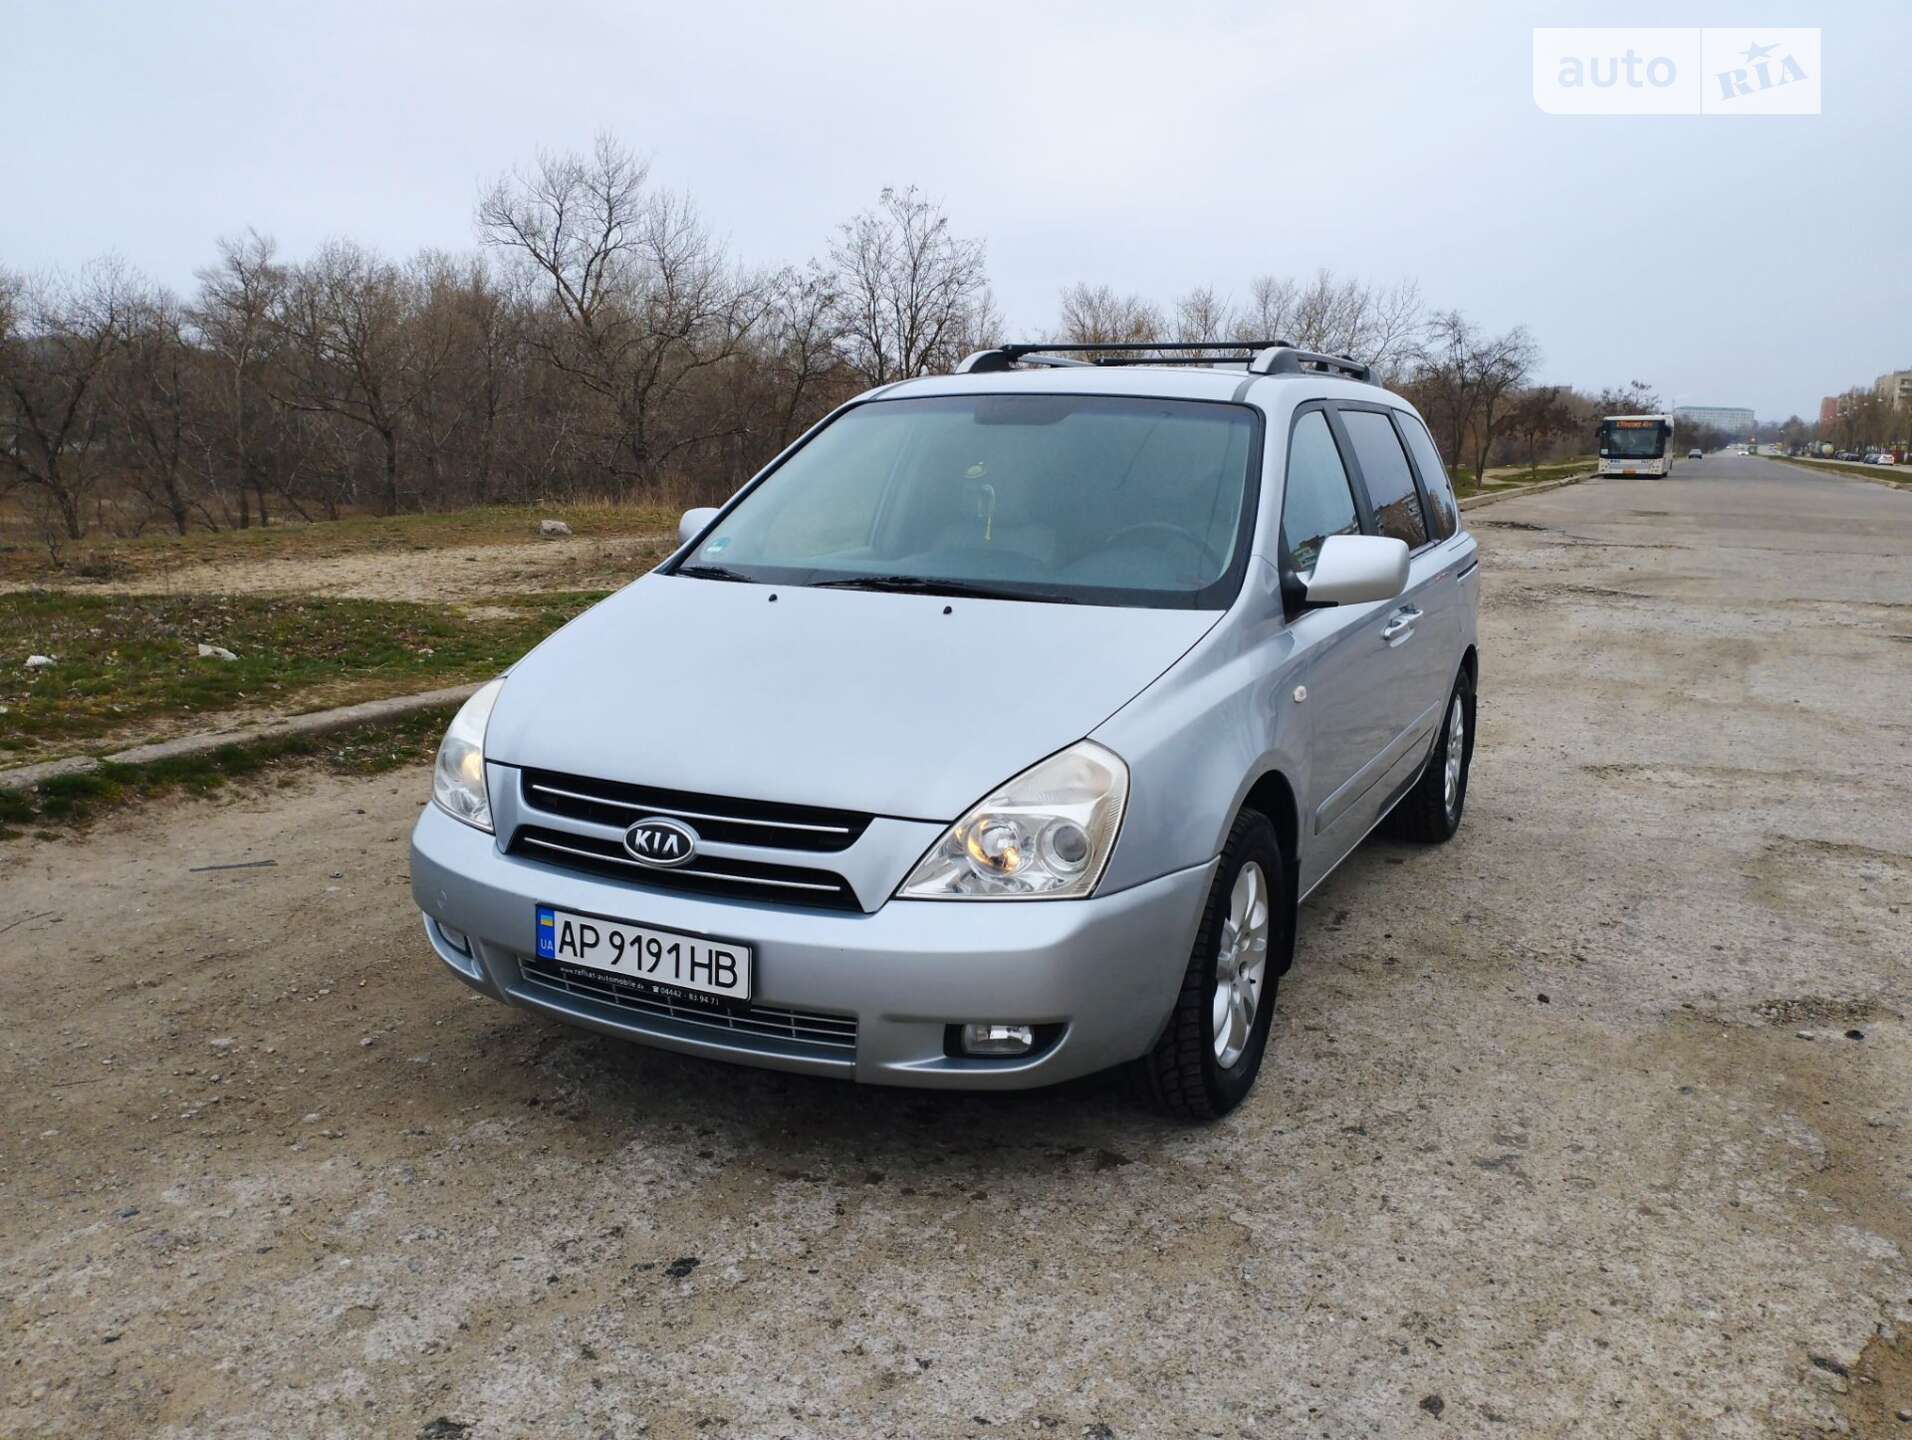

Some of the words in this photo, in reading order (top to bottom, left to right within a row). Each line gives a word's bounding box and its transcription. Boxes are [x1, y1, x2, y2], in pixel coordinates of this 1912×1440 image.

[634, 829, 680, 857] KIA
[539, 937, 554, 951] UA
[558, 920, 600, 958] AP
[609, 931, 681, 979] 9191
[689, 945, 738, 988] HB
